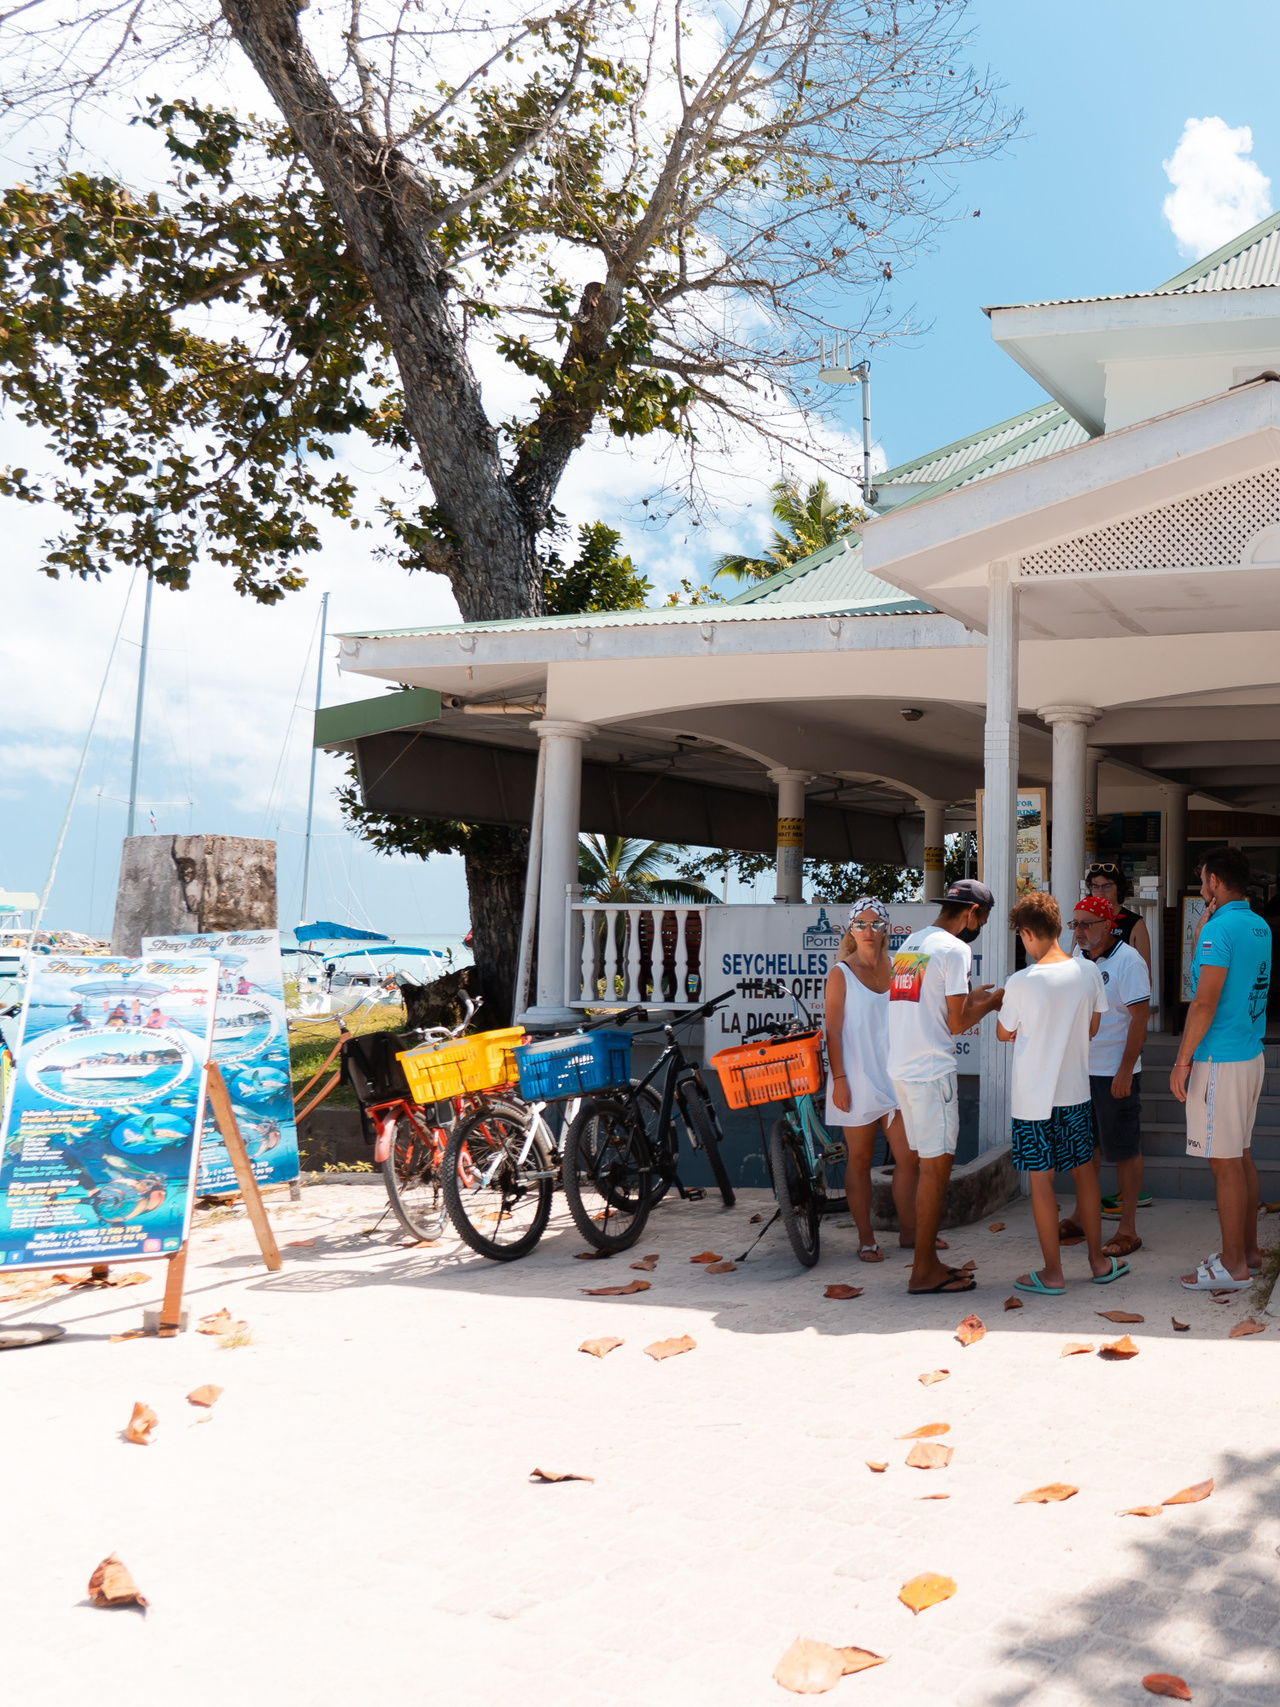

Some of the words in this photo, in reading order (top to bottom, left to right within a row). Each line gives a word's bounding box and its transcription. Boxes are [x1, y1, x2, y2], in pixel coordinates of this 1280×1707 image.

[1023, 856, 1041, 864] JUICE
[1252, 927, 1269, 938] CREW
[188, 937, 224, 949] Boat
[226, 934, 273, 946] Charter
[806, 935, 840, 947] Ports
[94, 962, 143, 974] Boat
[146, 961, 207, 974] Charter
[722, 953, 828, 975] SEYCHELLES
[741, 978, 786, 999] HEAD
[894, 973, 914, 990] VIBES
[252, 1000, 273, 1016] fishing
[721, 1012, 741, 1034] LA
[34, 1038, 66, 1058] Islands
[69, 1028, 104, 1040] cruises
[115, 1027, 132, 1035] Big
[135, 1028, 162, 1039] game
[163, 1035, 188, 1055] fishing
